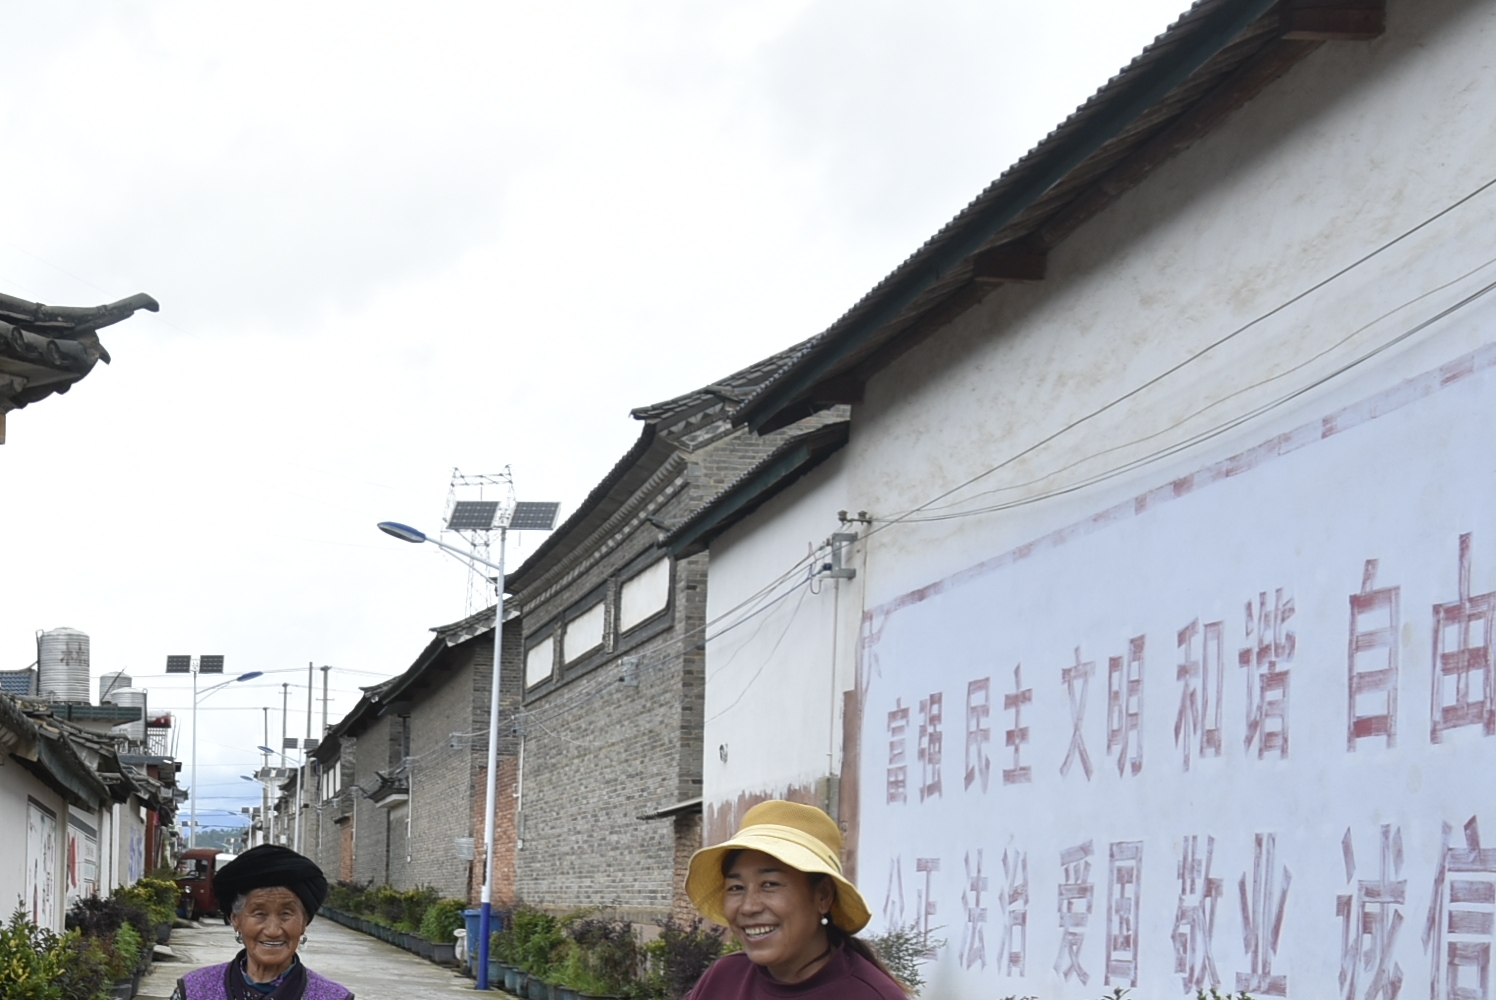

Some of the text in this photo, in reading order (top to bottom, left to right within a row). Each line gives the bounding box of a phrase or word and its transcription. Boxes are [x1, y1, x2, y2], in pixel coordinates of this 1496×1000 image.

[886, 532, 1496, 805] 富强 民主 文明 和谐 自由
[960, 838, 1030, 977] 法治
[1053, 839, 1145, 988] 爱国
[1171, 833, 1292, 996] 敬业
